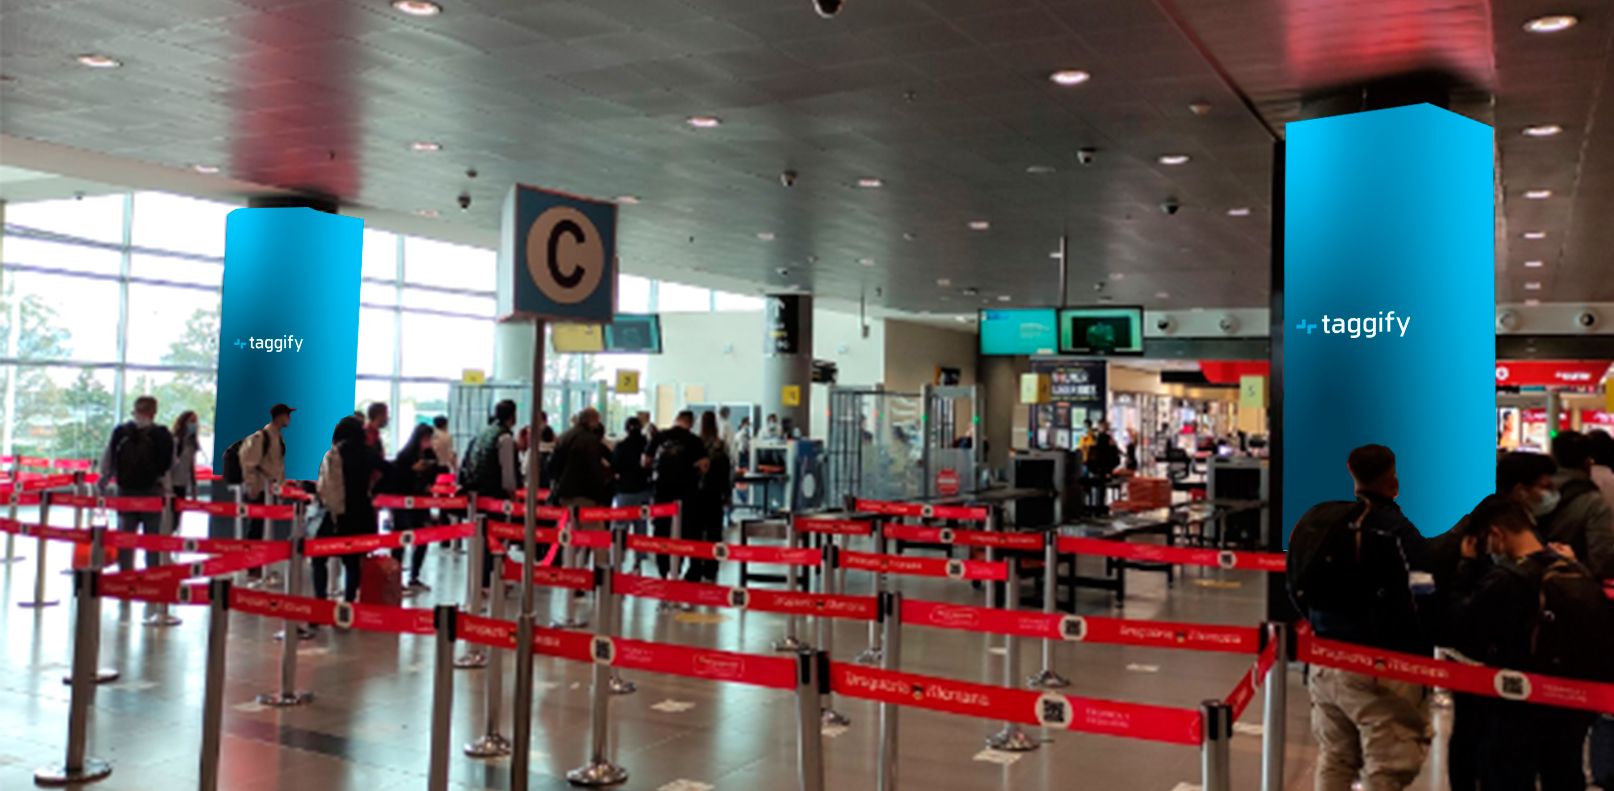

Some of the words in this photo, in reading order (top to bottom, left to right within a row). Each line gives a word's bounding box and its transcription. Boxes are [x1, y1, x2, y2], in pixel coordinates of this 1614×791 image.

[547, 219, 585, 289] C
[1321, 310, 1411, 339] taggify
[248, 334, 304, 353] taggify
